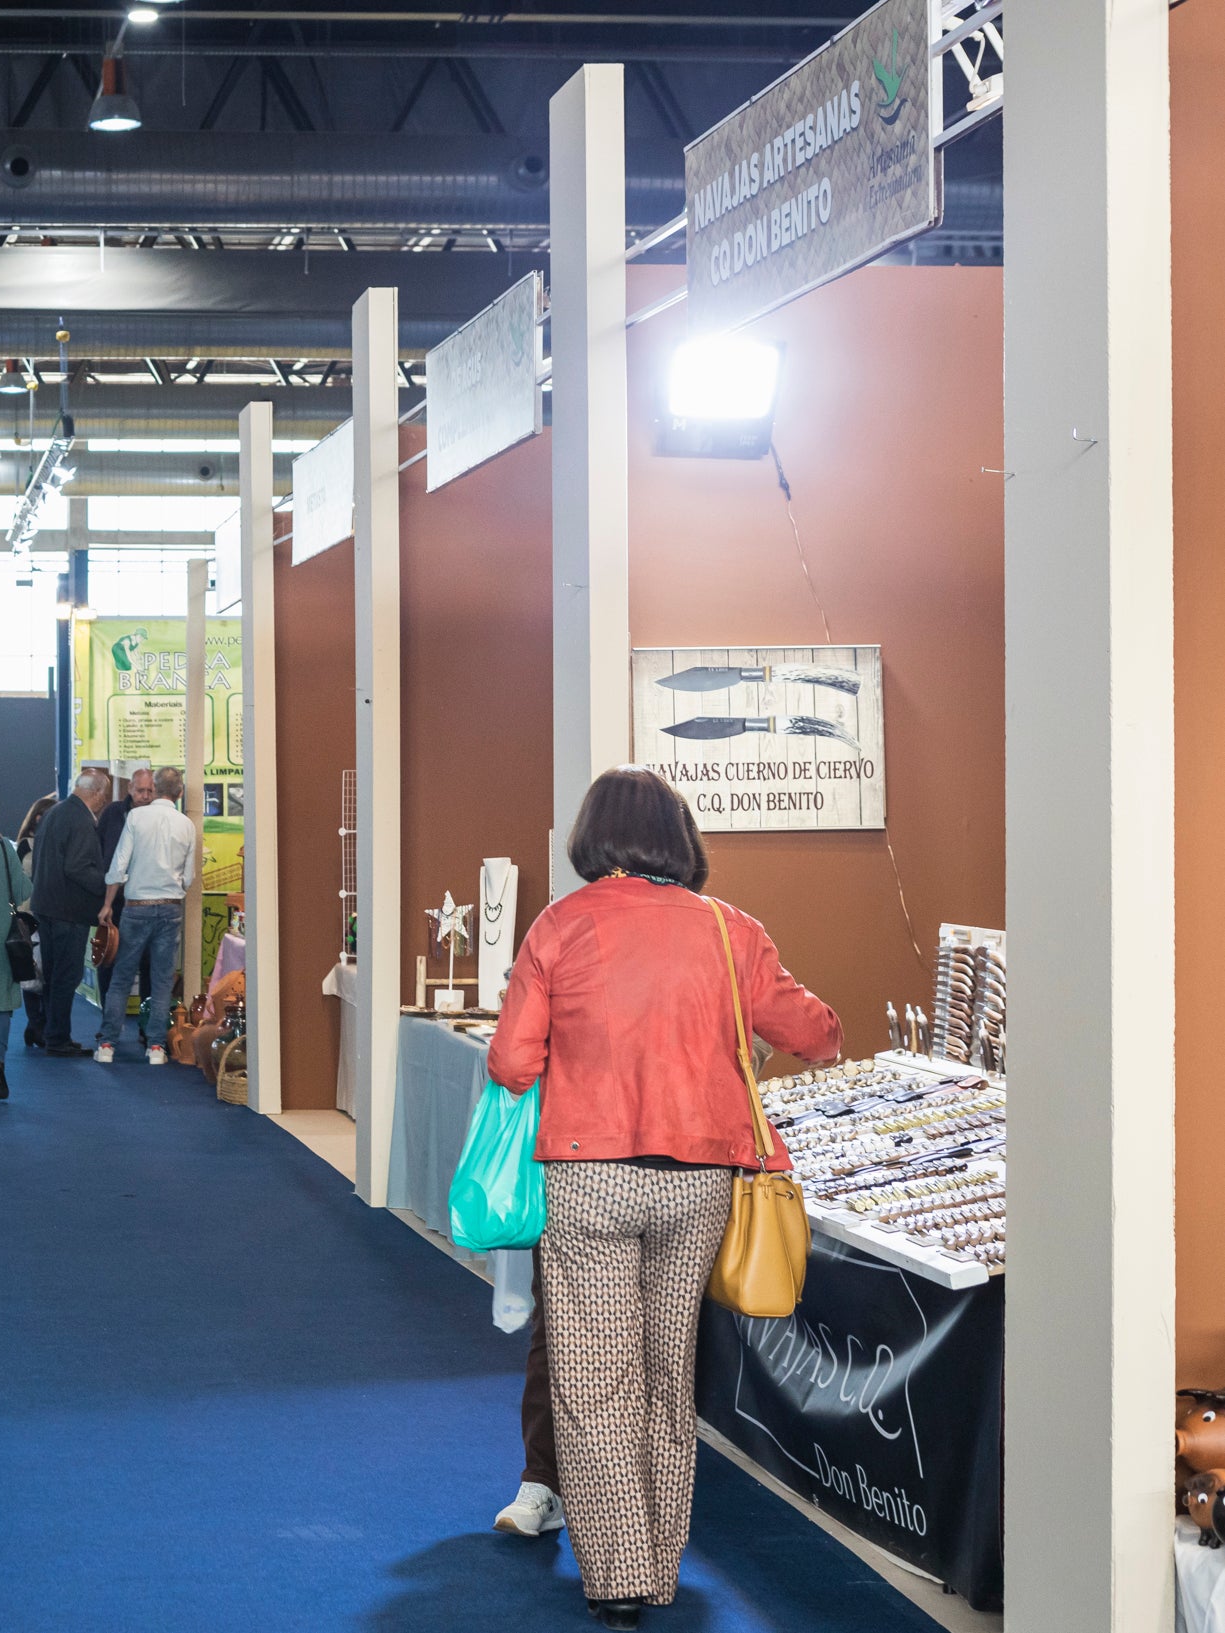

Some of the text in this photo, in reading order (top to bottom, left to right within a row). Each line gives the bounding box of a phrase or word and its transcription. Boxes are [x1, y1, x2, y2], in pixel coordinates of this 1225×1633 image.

[694, 80, 861, 232] NAVAJAS ARTESANAS
[710, 177, 832, 287] CQ DON BENITO
[696, 791, 824, 814] C.Q. DON BENITO
[726, 761, 788, 782] CUERNO
[793, 761, 812, 780] DE
[817, 758, 874, 780] CIERVO
[813, 1442, 927, 1536] Don Benito
